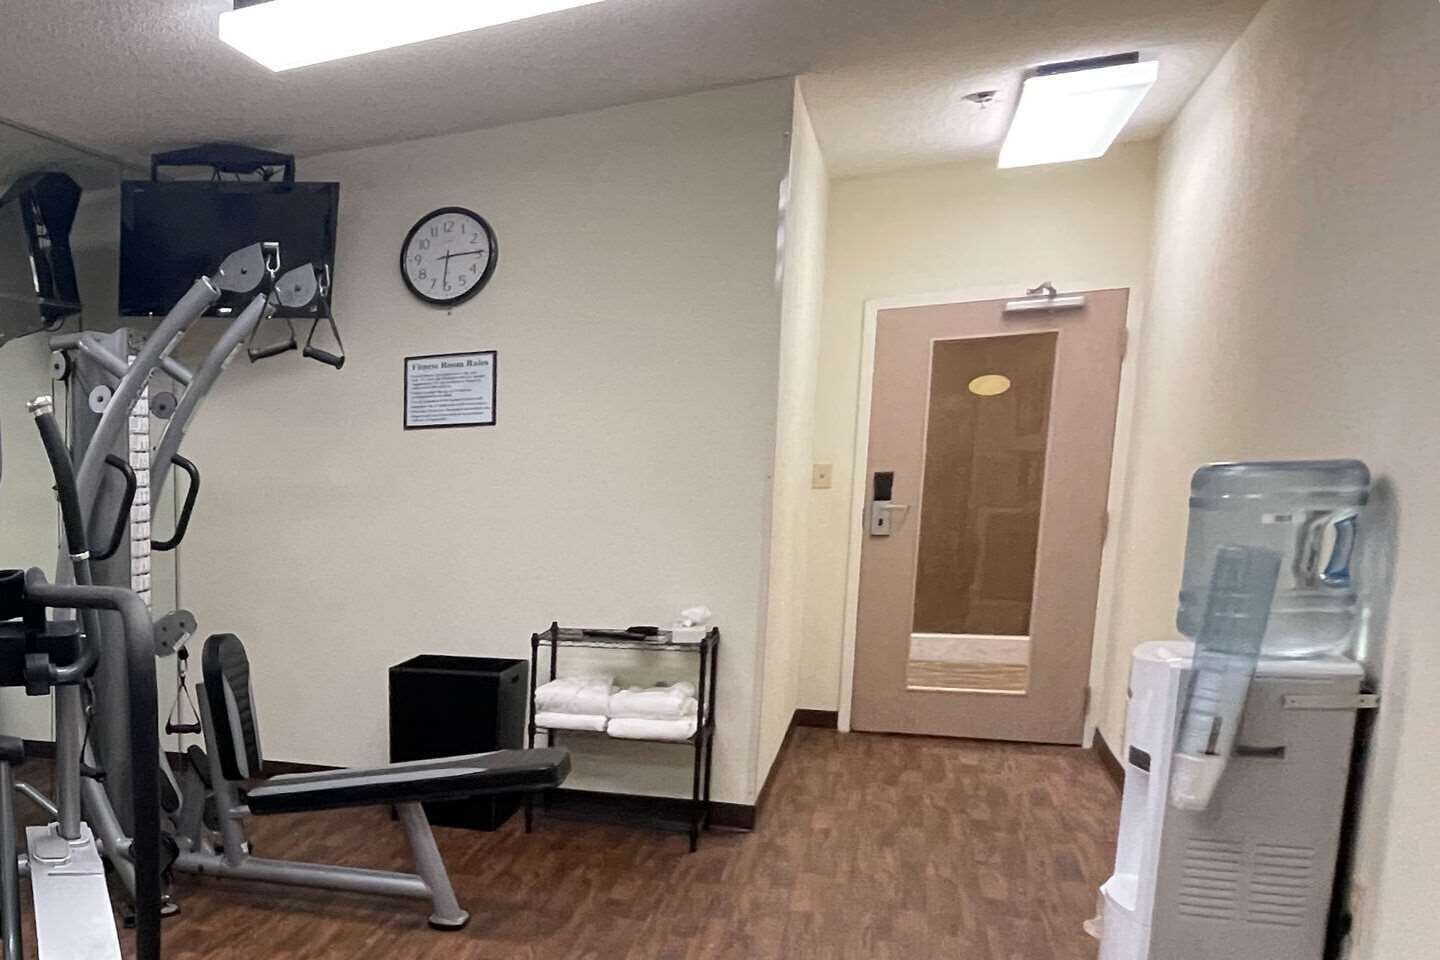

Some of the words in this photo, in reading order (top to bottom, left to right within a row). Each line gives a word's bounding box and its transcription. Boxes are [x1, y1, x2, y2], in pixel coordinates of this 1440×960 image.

[430, 226, 439, 238] 11
[442, 220, 455, 233] 12
[418, 238, 430, 250] 10
[469, 232, 479, 244] 2
[414, 254, 423, 266] 9
[418, 269, 427, 280] 8
[469, 263, 477, 274] 4
[430, 278, 437, 289] 7
[458, 274, 466, 286] 5
